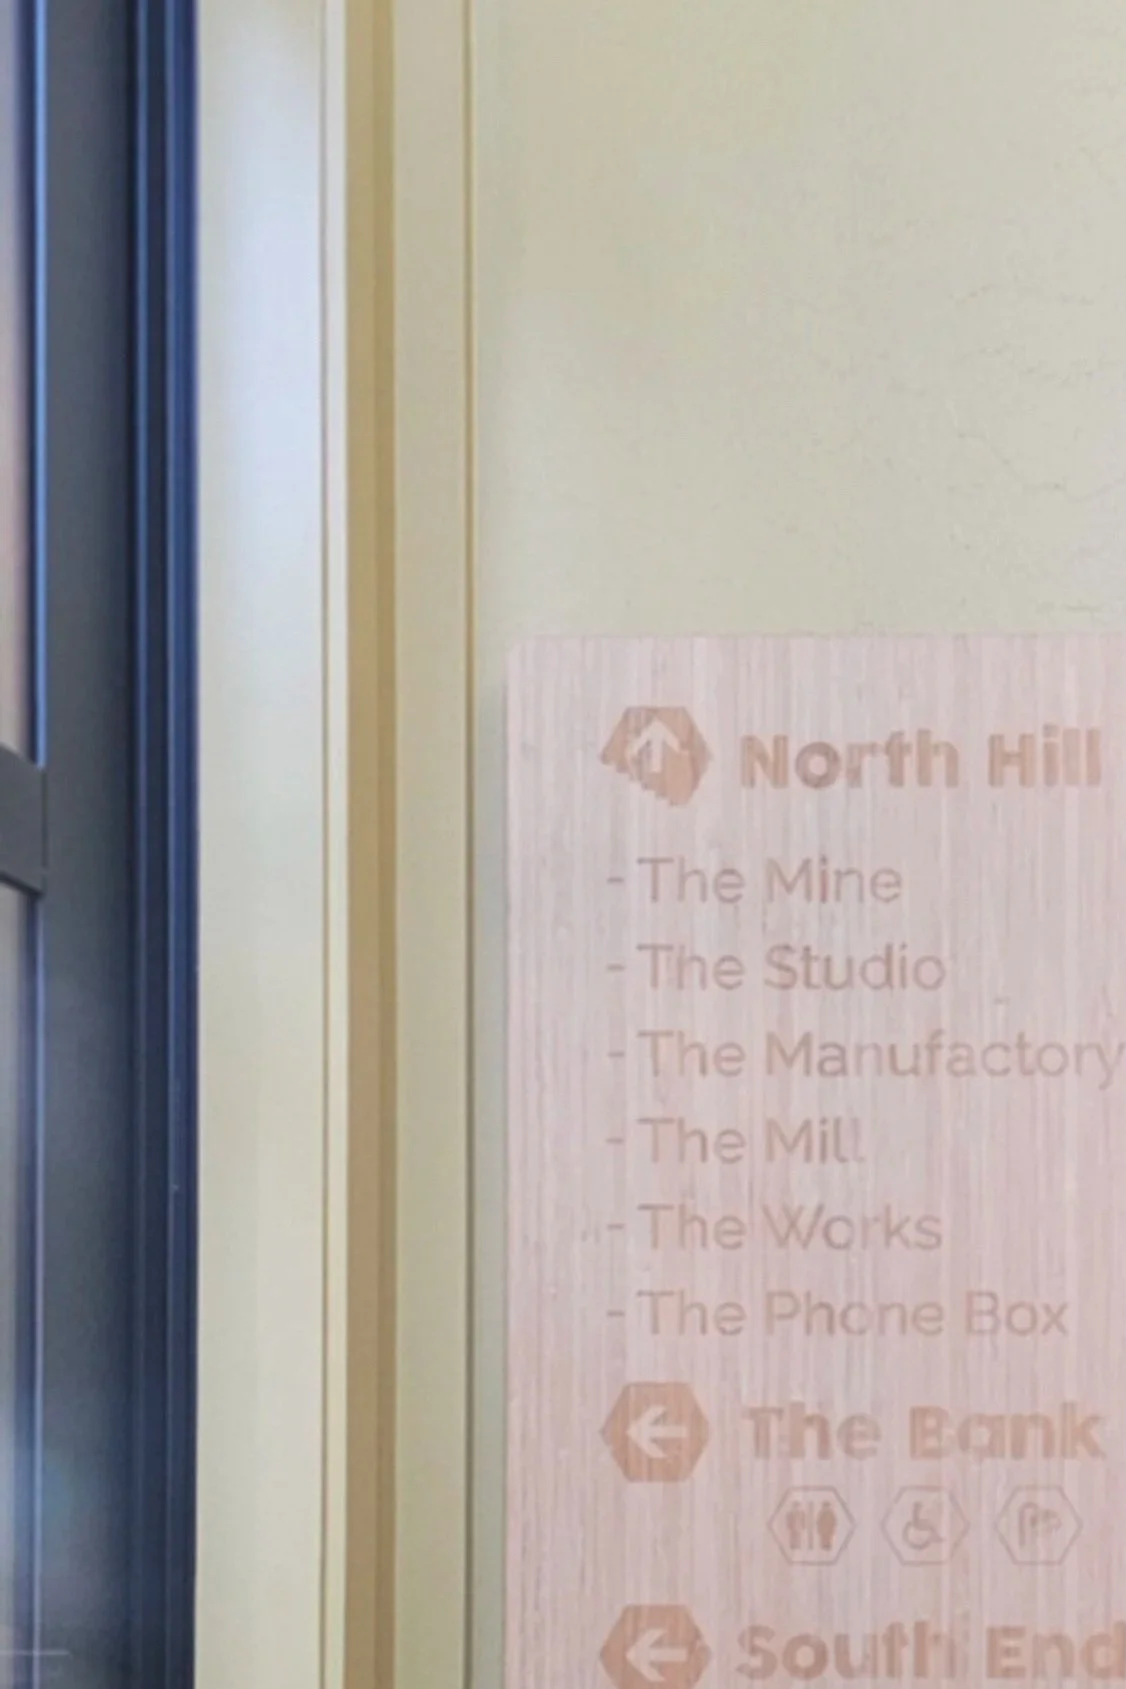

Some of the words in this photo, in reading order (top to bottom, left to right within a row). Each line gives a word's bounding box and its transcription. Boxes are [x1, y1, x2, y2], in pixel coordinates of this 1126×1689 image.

[740, 728, 960, 789] North
[988, 724, 1103, 789] Hill
[637, 857, 745, 903] The
[765, 855, 904, 903] Mine
[637, 943, 745, 991] The
[763, 942, 948, 992] Studio
[637, 1030, 745, 1078] The
[765, 1028, 1126, 1090] Manufactory
[637, 1117, 745, 1164] The
[765, 1116, 866, 1164] Mill
[637, 1204, 745, 1251] The
[760, 1203, 944, 1251] Works
[637, 1289, 745, 1336] The
[765, 1289, 945, 1336] Phone
[964, 1289, 1069, 1336] Box
[741, 1403, 881, 1461] The
[908, 1402, 1106, 1461] Bank
[734, 1620, 957, 1681] South
